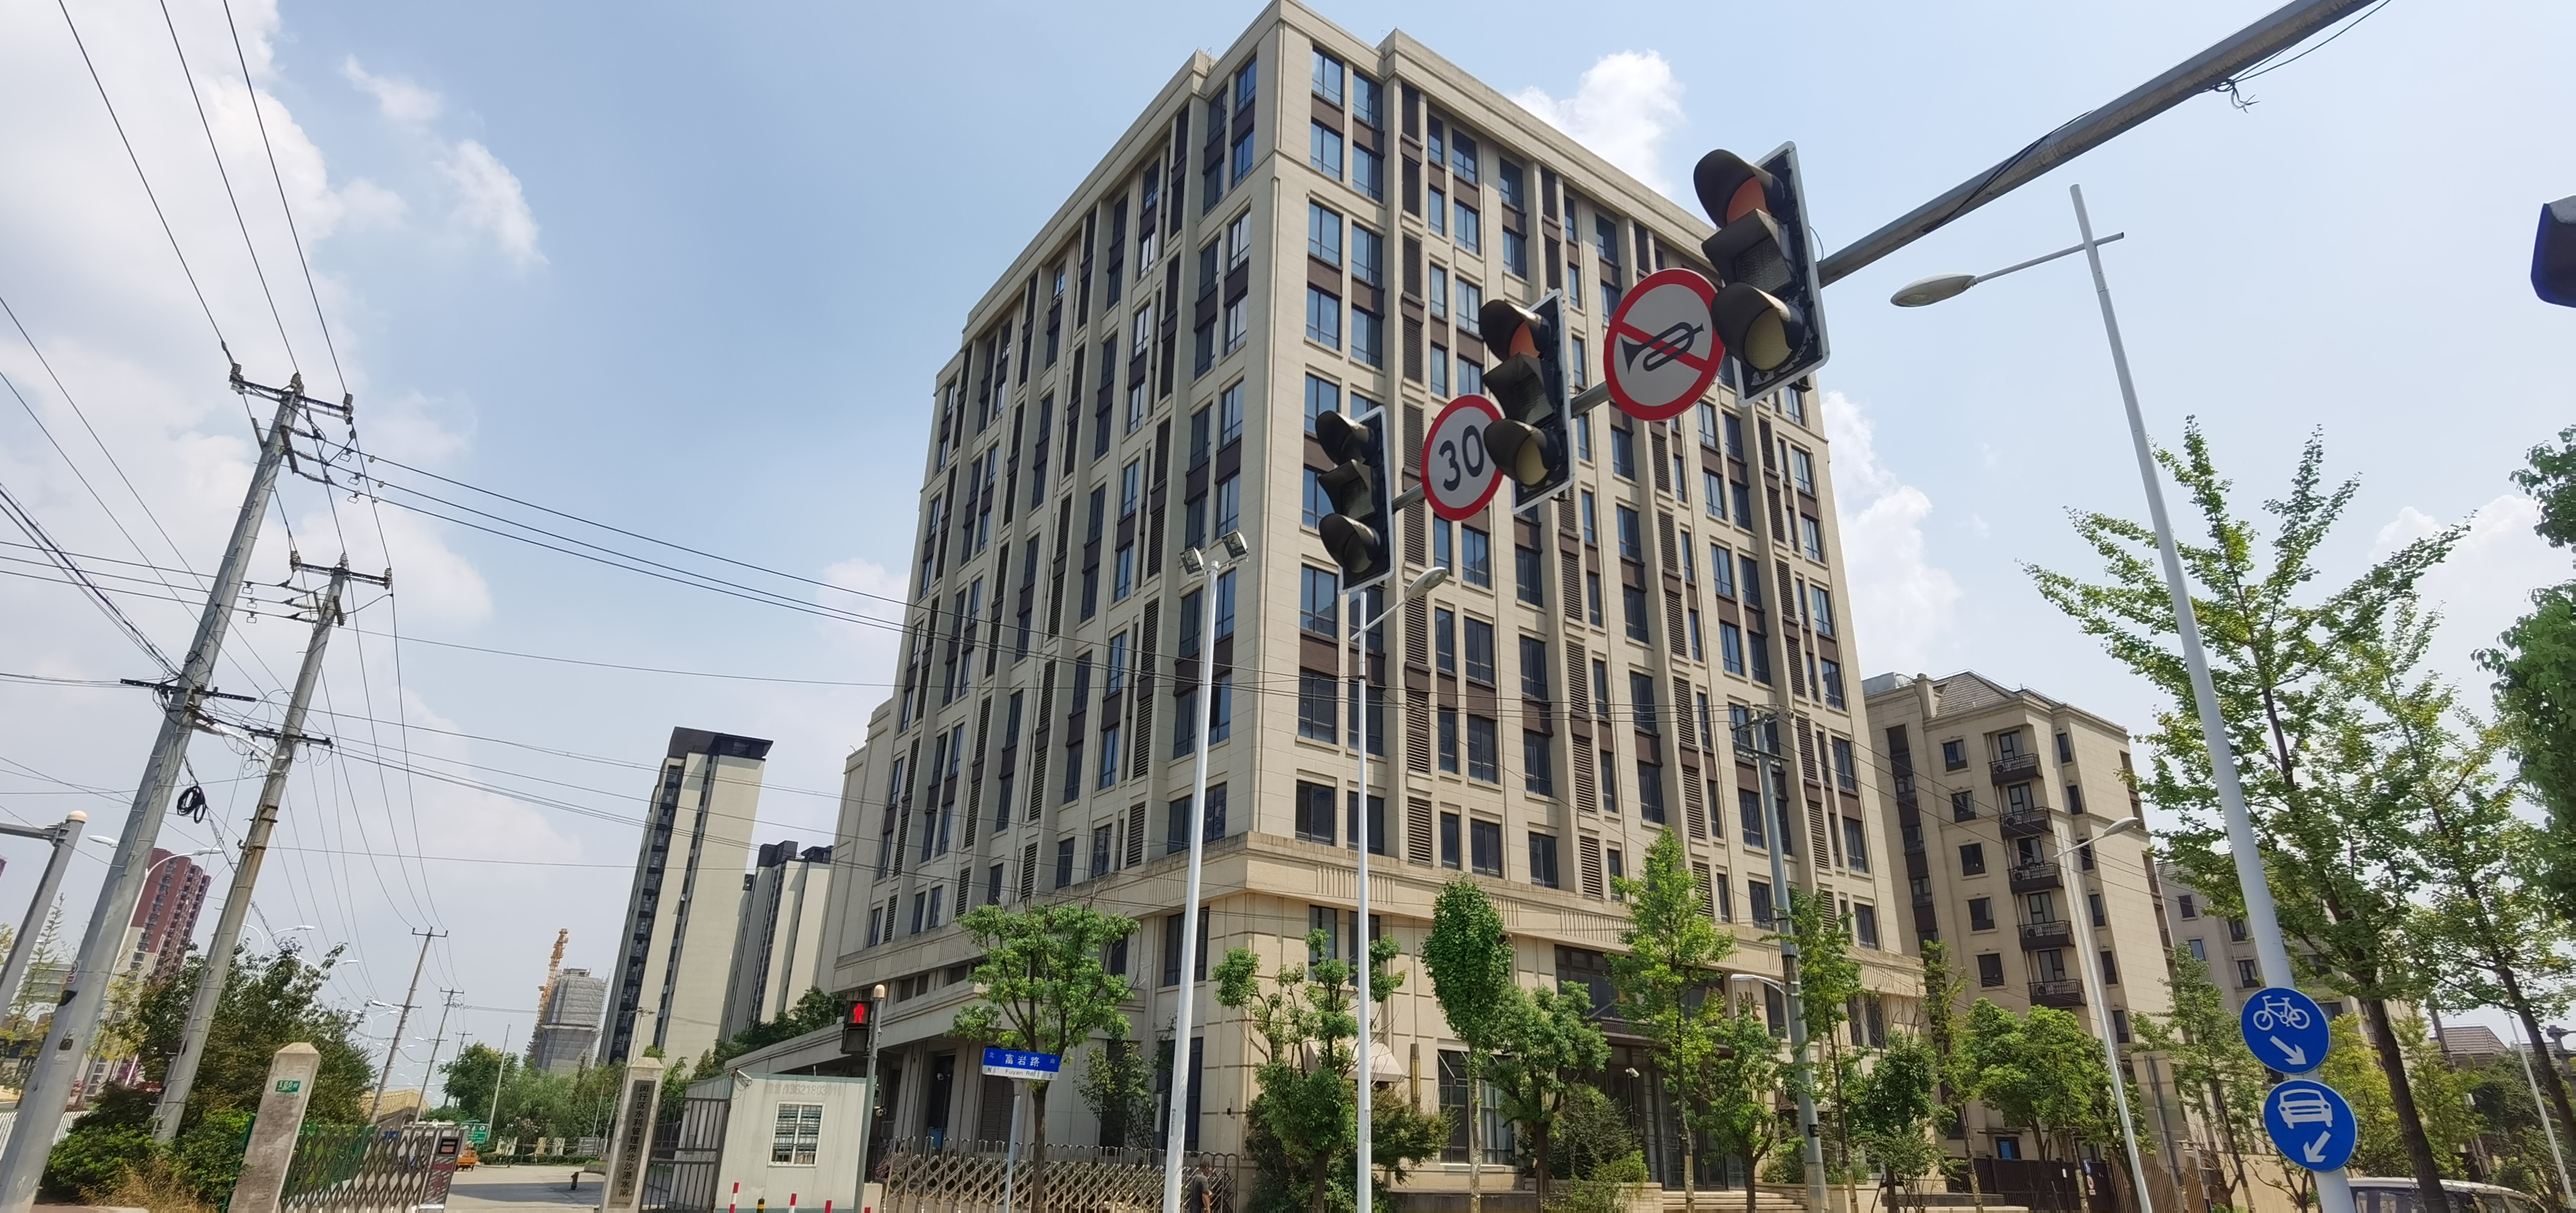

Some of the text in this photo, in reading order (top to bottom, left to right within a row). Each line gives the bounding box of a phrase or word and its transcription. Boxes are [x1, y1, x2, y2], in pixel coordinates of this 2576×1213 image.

[1438, 425, 1485, 491] 30
[1005, 1053, 1040, 1067] 富岩路
[619, 1084, 649, 1198] 闵行区水利管理所北沙港水闸
